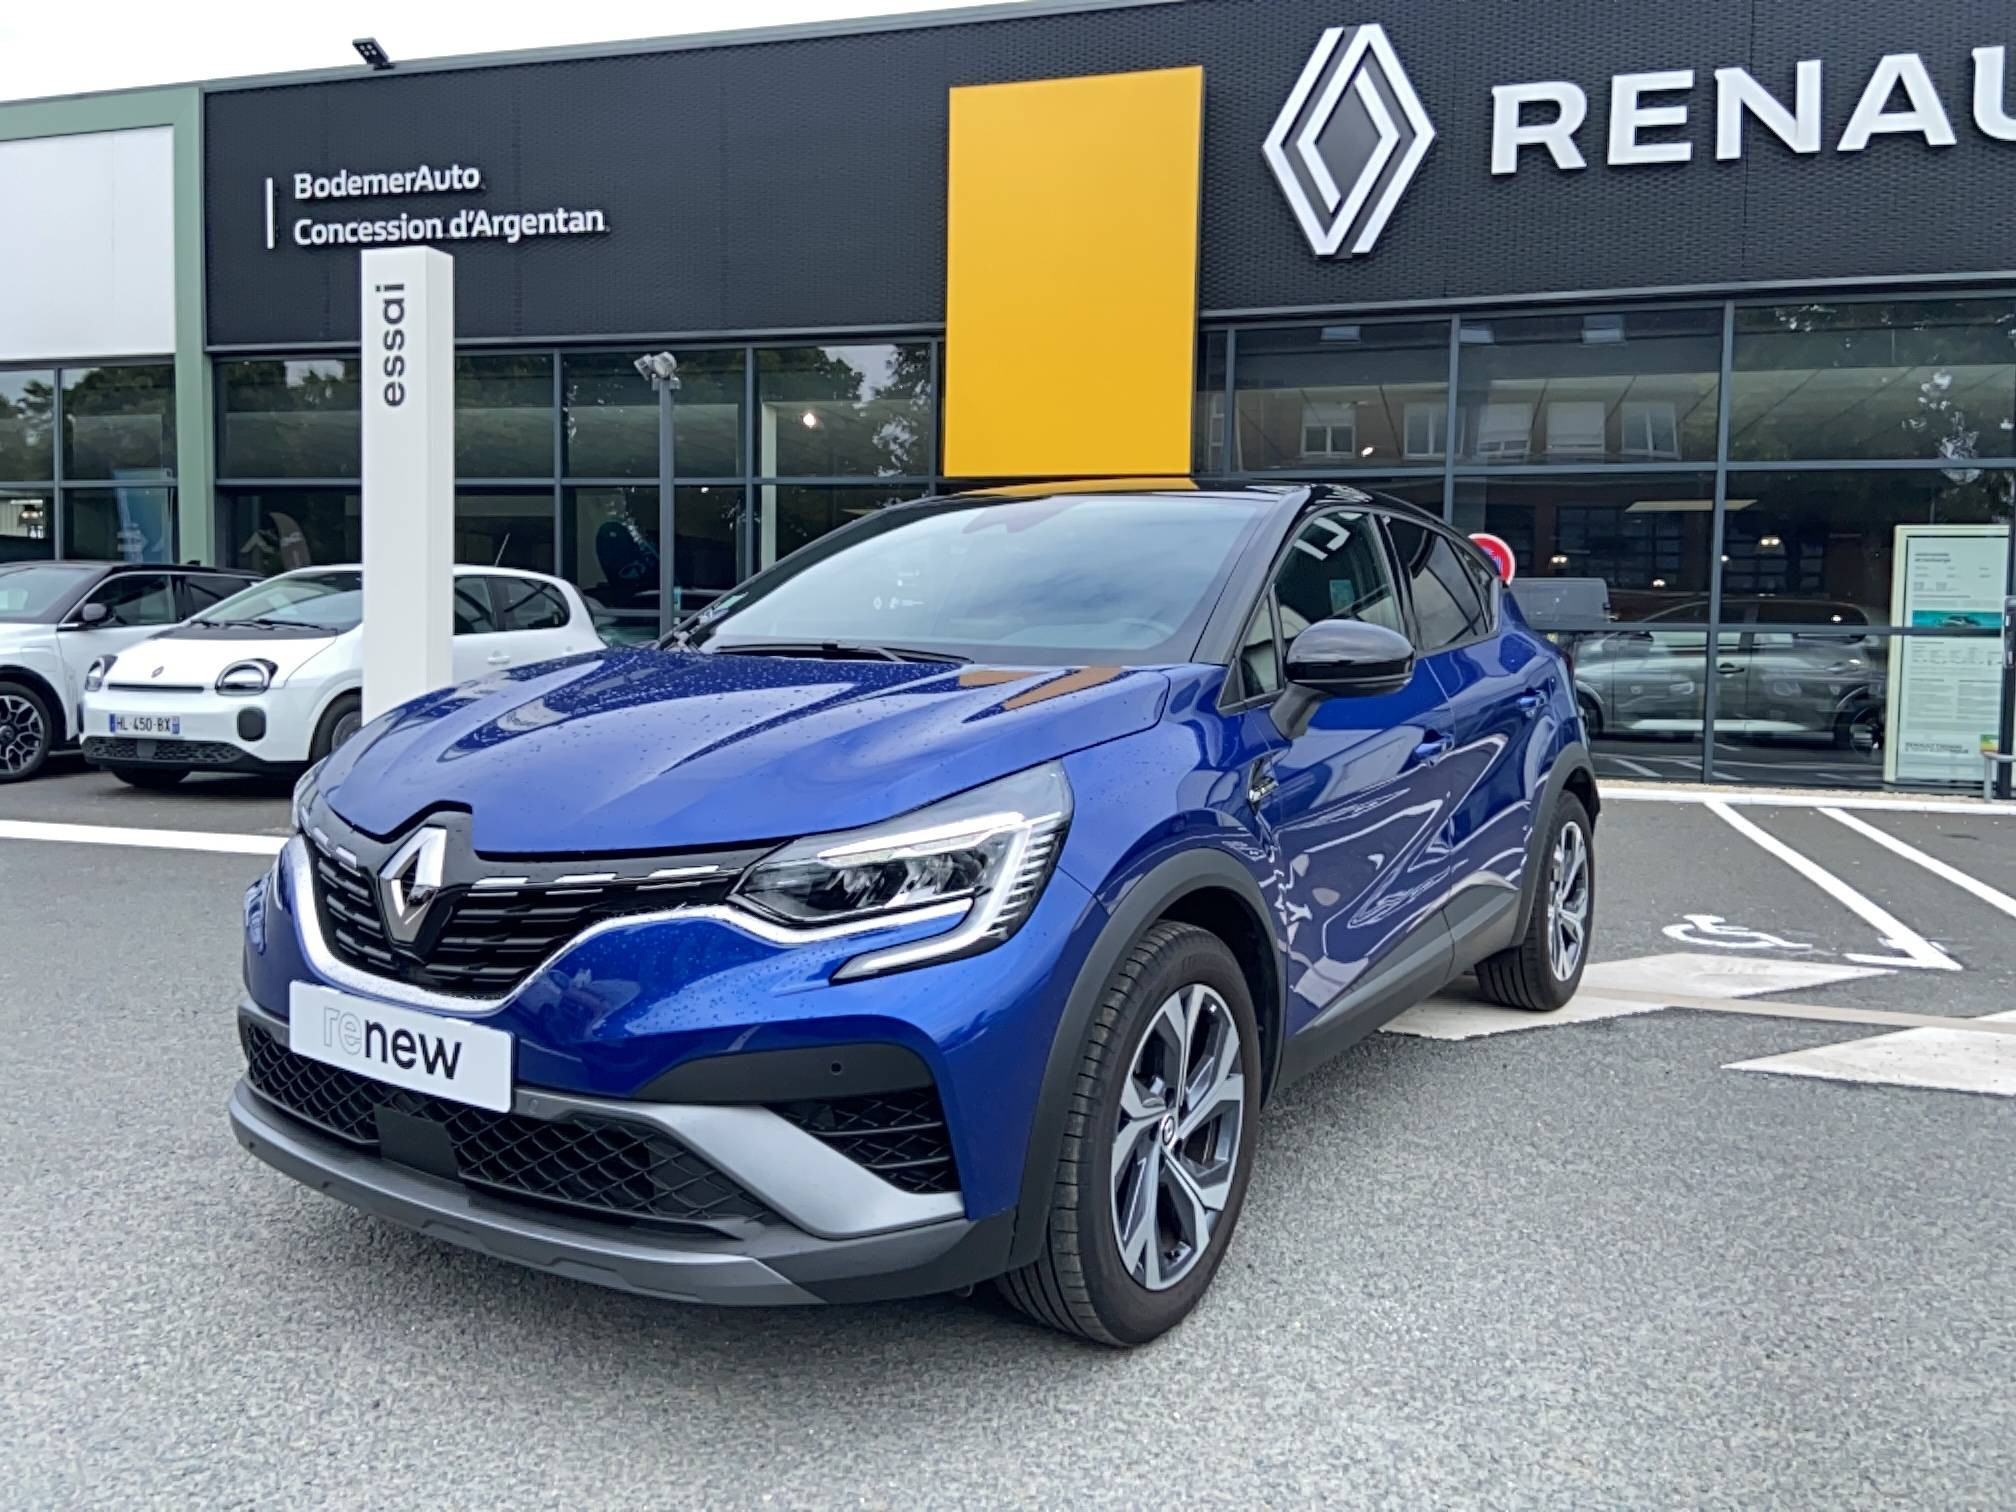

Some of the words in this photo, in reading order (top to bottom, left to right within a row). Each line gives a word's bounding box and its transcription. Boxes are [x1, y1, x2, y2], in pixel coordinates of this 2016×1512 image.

[294, 164, 480, 199] BodemerAuto
[293, 212, 444, 245] Concession
[448, 207, 605, 243] d'Argentan
[375, 284, 405, 407] essai
[323, 1006, 462, 1080] renew
